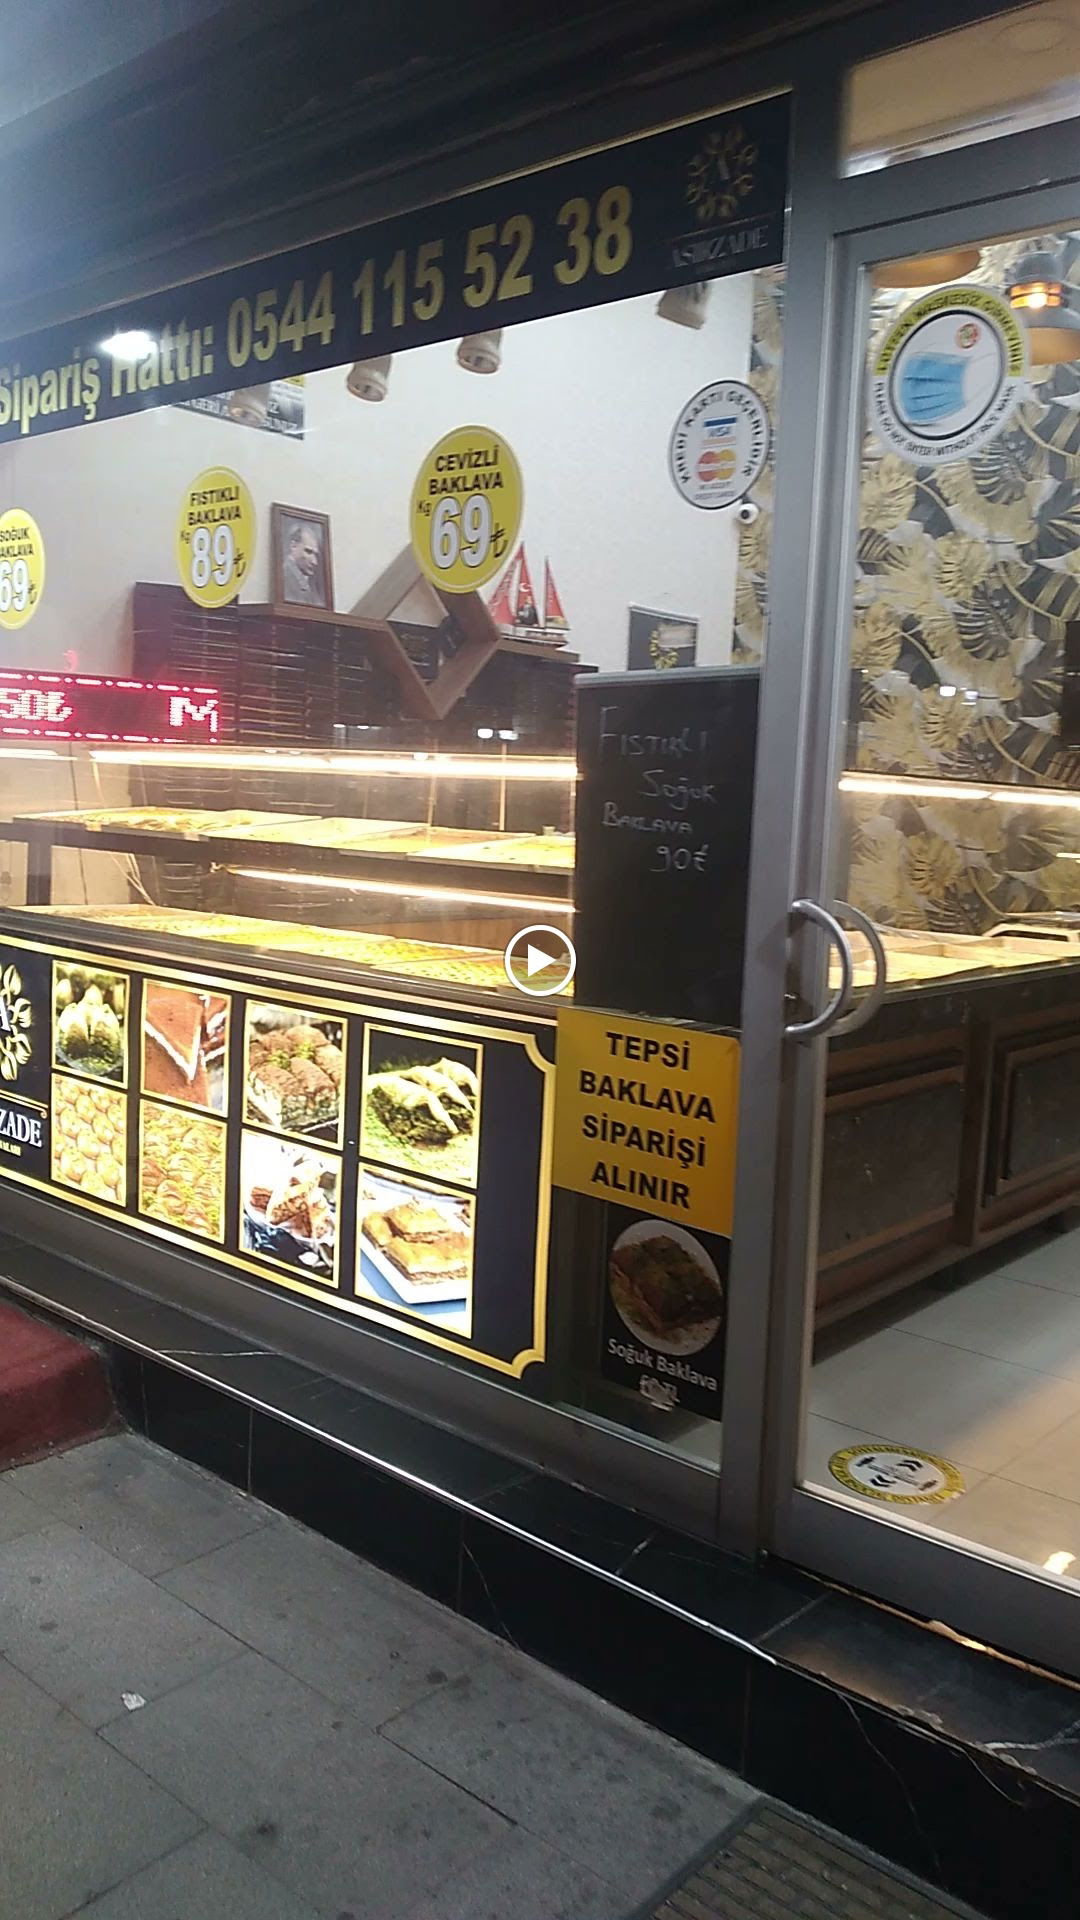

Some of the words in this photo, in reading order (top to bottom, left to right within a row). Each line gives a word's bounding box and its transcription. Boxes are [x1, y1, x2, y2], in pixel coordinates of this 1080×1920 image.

[227, 270, 336, 368] 0544
[353, 239, 445, 336] 115
[463, 214, 534, 308] 52
[554, 185, 632, 285] 38
[434, 445, 500, 472] CEVİZLİ
[190, 486, 240, 506] FISTIKLI
[428, 471, 505, 495] BAKLAVA
[187, 505, 242, 526] BAKLAVA
[606, 1031, 691, 1071] TEPSİ
[579, 1069, 716, 1124] BAKLAVA
[581, 1112, 707, 1169] SİPARİŞİ
[591, 1160, 691, 1210] ALINIR
[607, 1338, 654, 1368] Soğuk
[656, 1355, 718, 1391] Baklava
